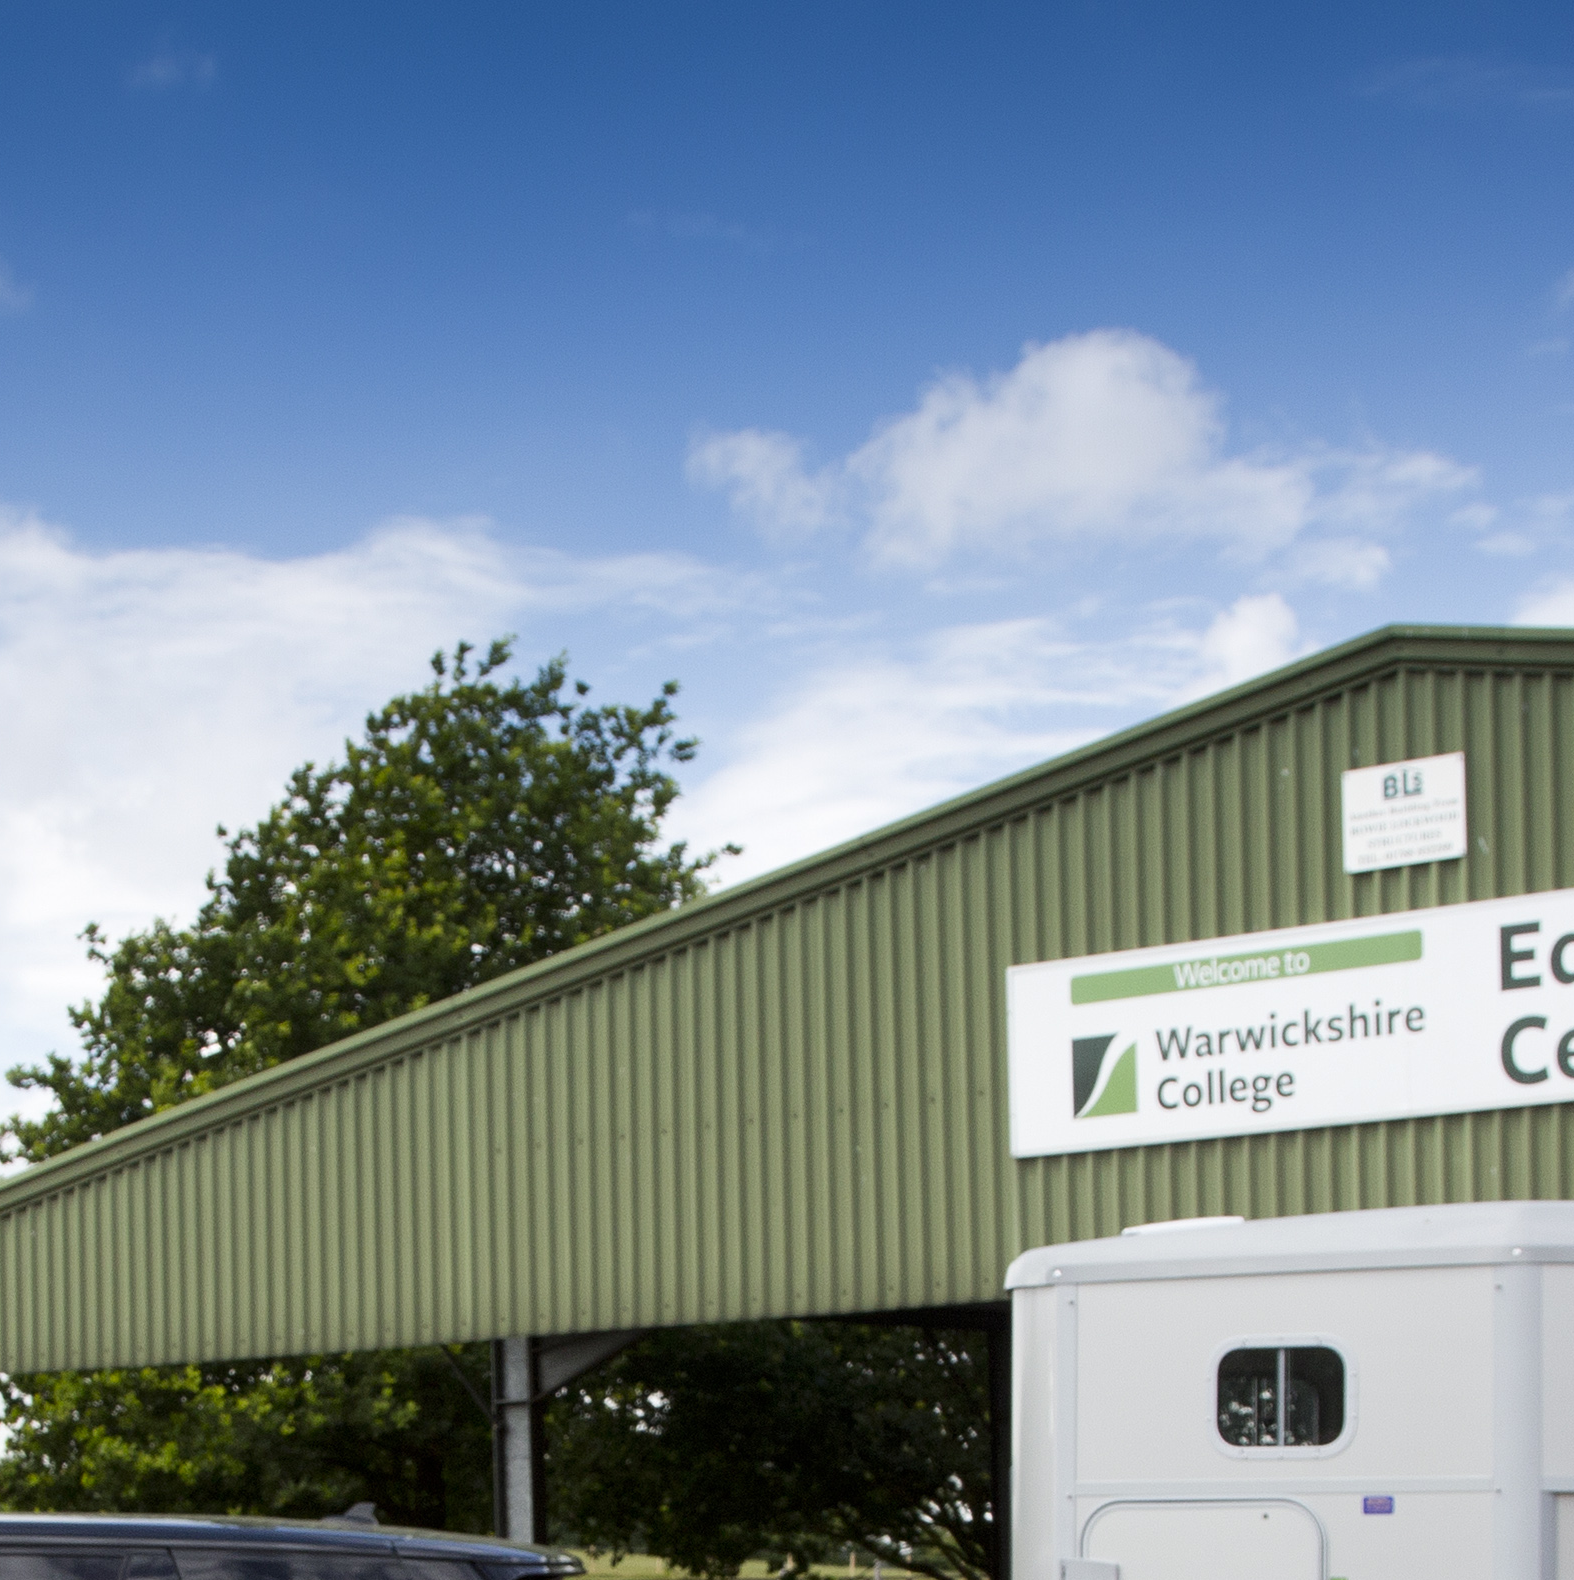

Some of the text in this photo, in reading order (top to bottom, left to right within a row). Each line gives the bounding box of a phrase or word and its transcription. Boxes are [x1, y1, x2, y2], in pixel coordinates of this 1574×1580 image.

[1173, 950, 1311, 989] Welcome to
[1156, 999, 1424, 1061] Warwickshire
[1157, 1069, 1295, 1113] College
